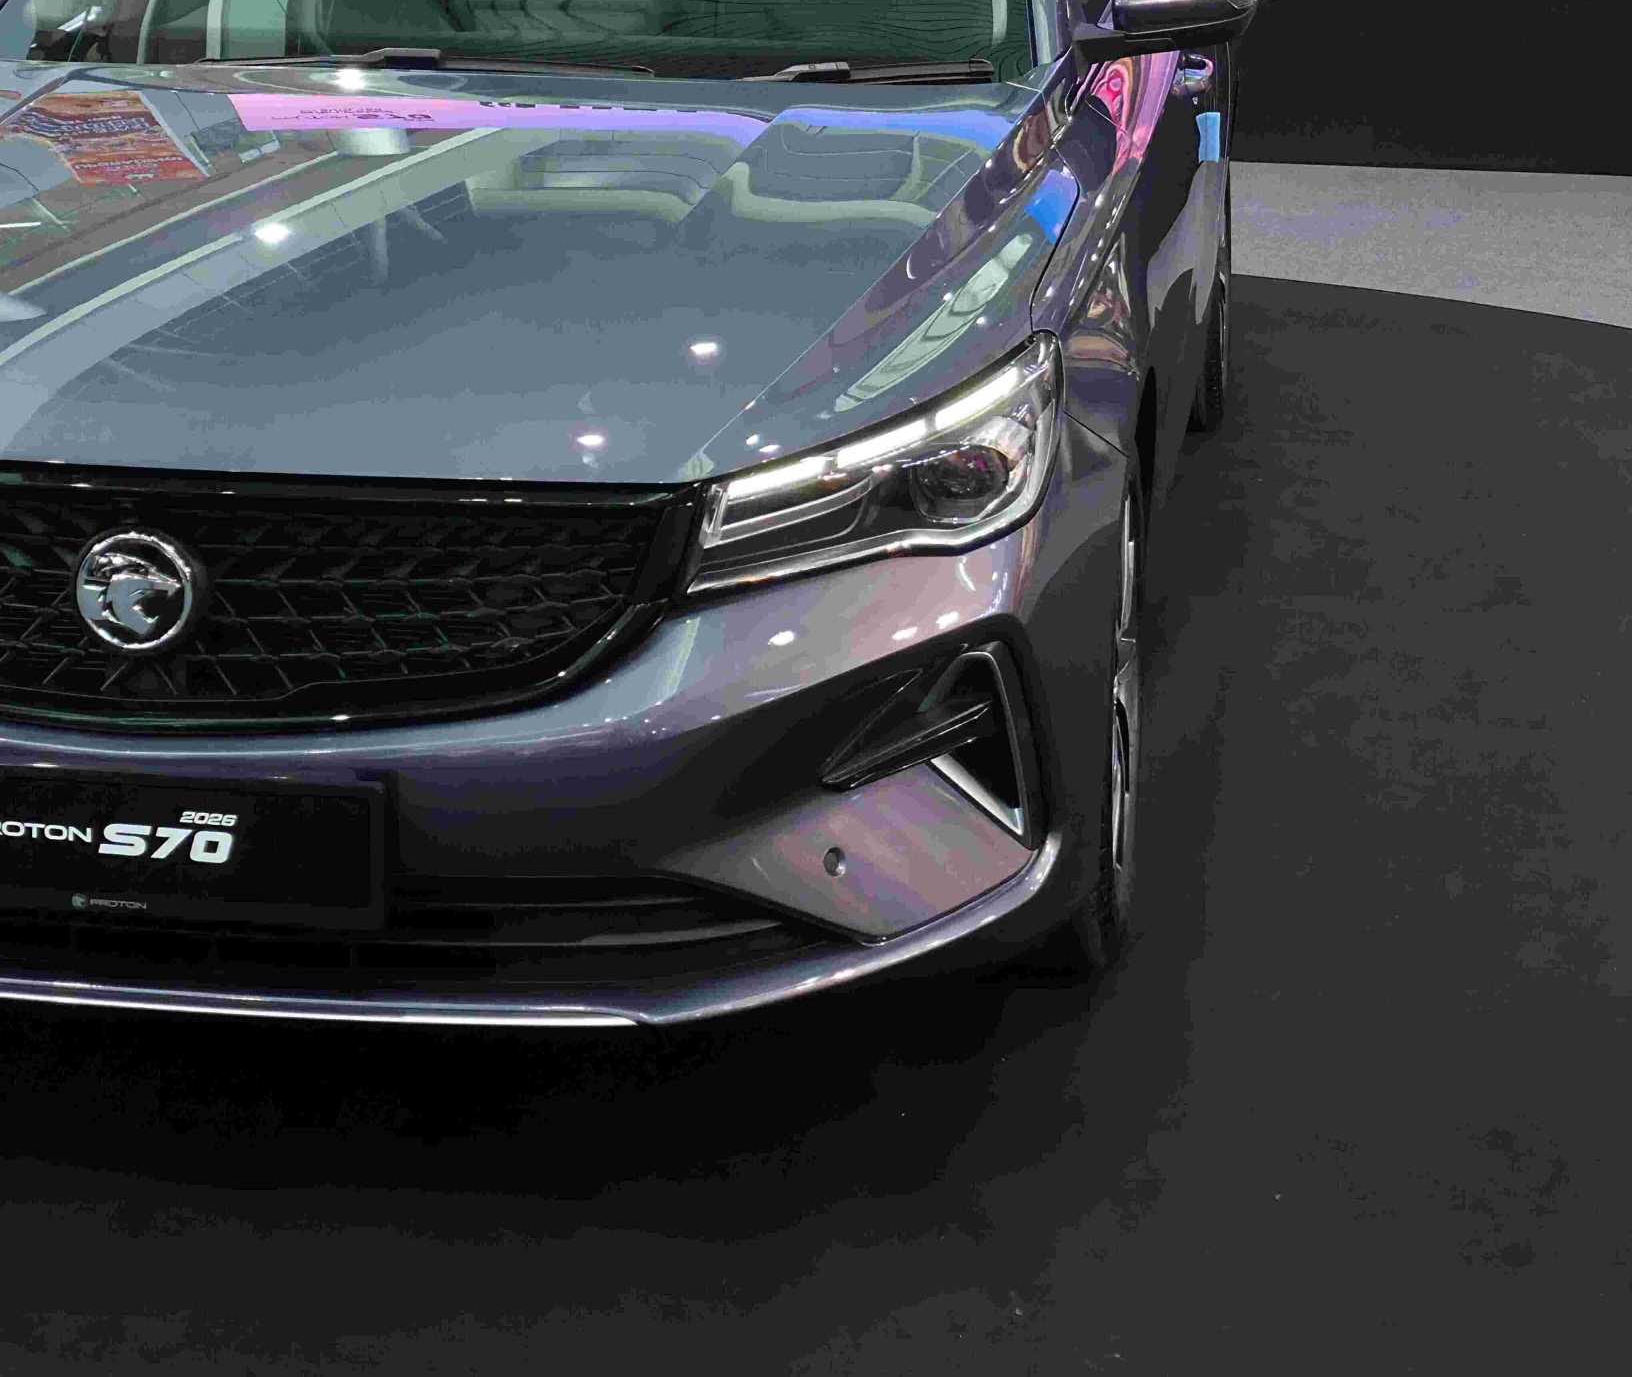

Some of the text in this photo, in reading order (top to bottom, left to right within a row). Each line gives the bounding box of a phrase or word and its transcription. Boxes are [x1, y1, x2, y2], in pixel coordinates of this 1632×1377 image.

[179, 810, 239, 828] 2026
[97, 822, 236, 864] S70
[89, 897, 148, 911] PROTON
